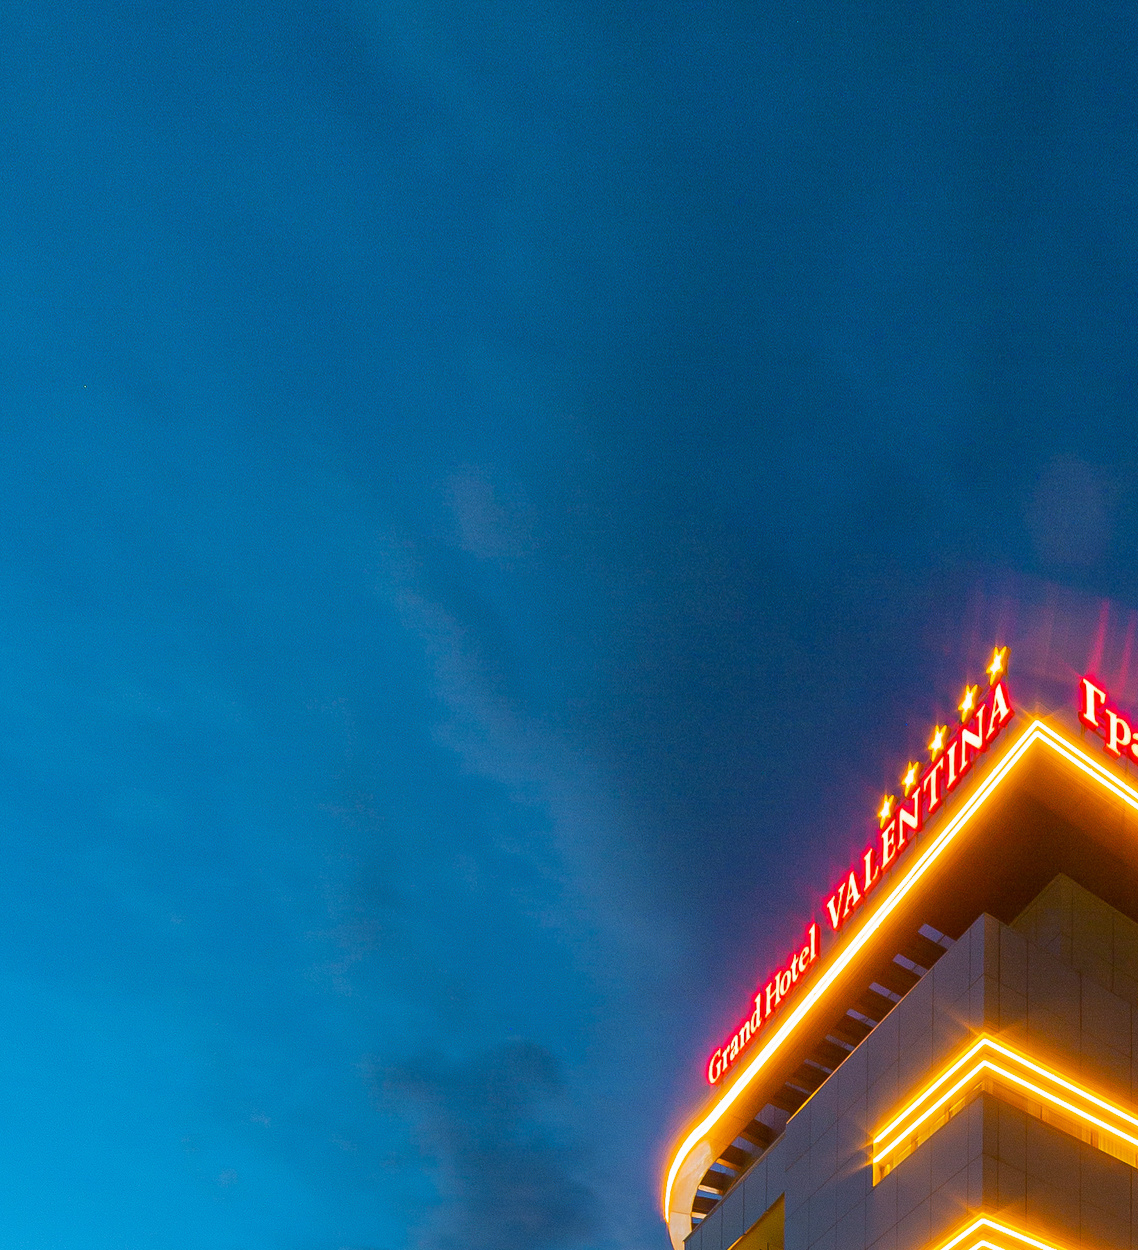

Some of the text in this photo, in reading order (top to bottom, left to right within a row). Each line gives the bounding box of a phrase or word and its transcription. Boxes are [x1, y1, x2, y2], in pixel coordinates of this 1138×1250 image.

[707, 682, 1011, 1084] Grand Hotel VALENTINA
